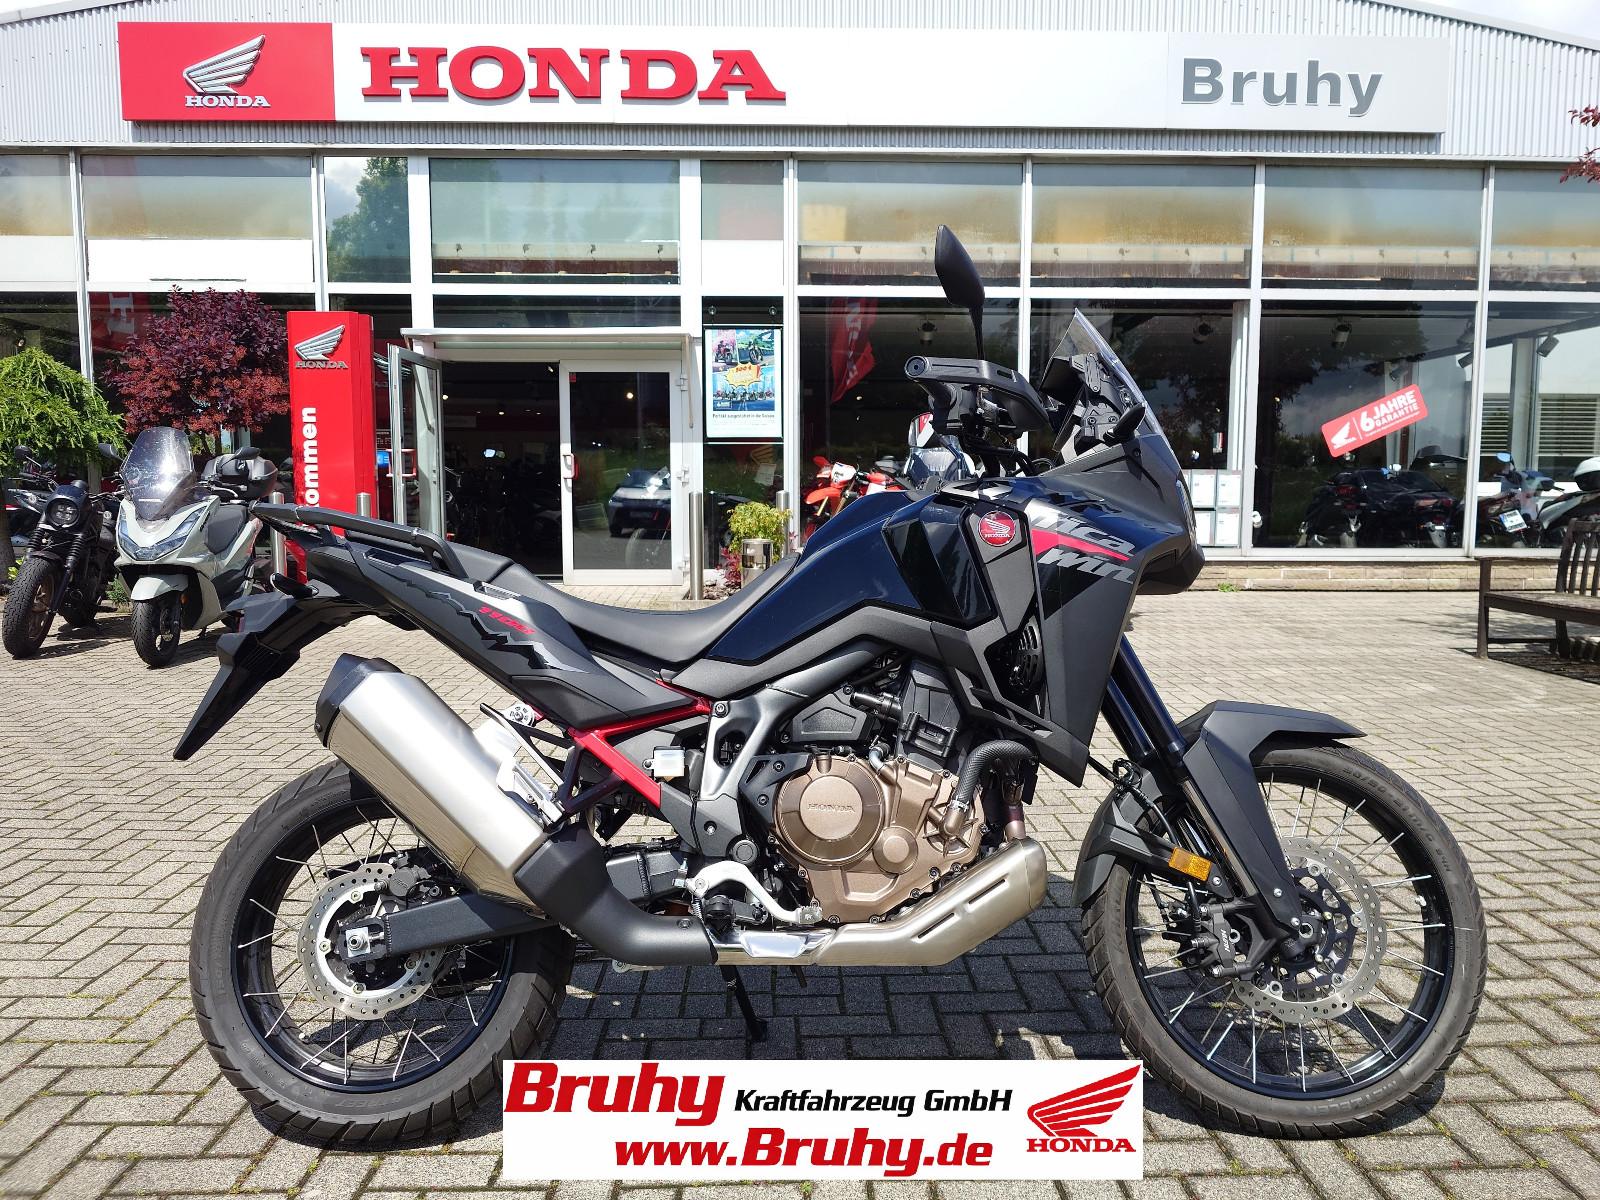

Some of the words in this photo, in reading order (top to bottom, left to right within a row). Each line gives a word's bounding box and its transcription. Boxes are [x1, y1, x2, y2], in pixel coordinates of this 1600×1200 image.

[360, 45, 787, 101] HONDA
[1182, 57, 1384, 118] Bruhy
[184, 95, 271, 107] HONDA
[295, 360, 349, 370] HONDA
[1360, 411, 1376, 432] 6
[1373, 390, 1418, 420] JAHRE
[1375, 402, 1419, 427] GARANTIE
[302, 407, 320, 507] ommen
[808, 803, 856, 813] HONDA
